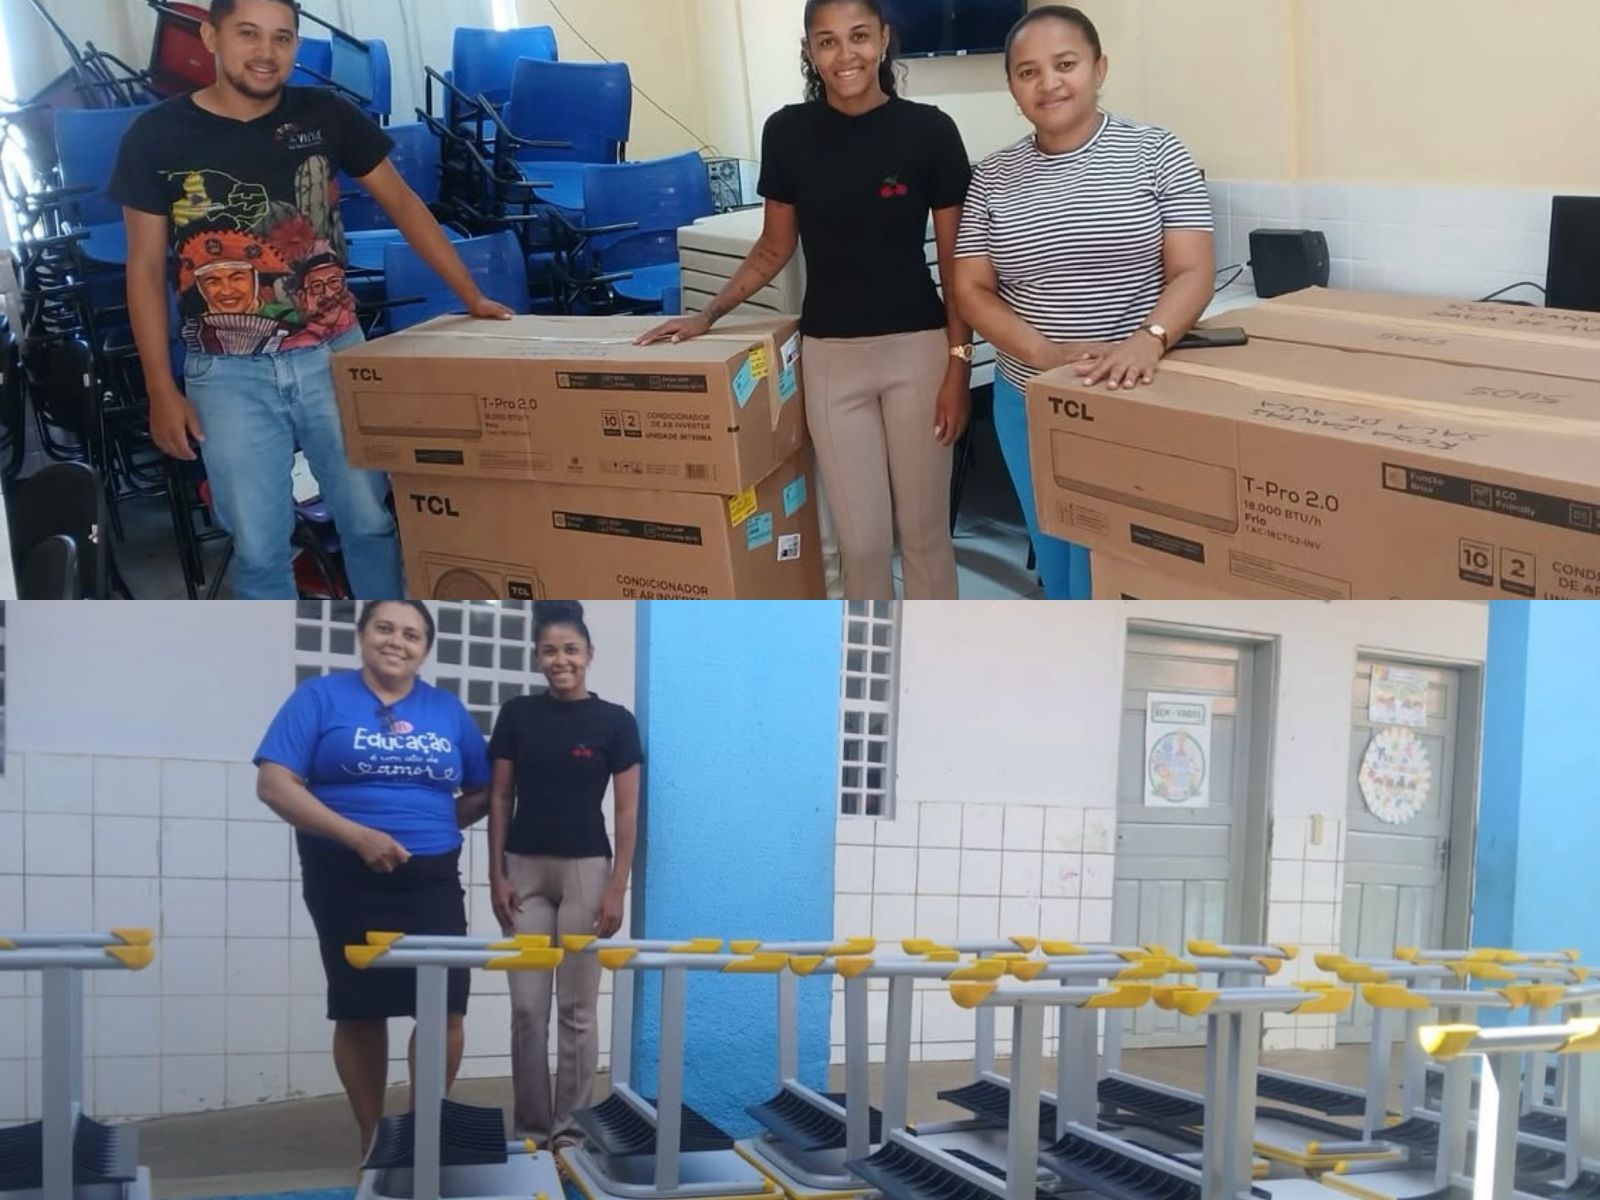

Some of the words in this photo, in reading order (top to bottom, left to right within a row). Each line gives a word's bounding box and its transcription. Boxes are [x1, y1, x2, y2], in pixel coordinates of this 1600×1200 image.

[348, 368, 383, 381] TCL
[481, 397, 516, 410] T-Pro
[1047, 396, 1094, 421] TCL
[604, 415, 617, 427] 10
[627, 415, 636, 427] 2
[646, 412, 710, 421] CONDICIONADOR
[1243, 476, 1300, 503] T-Pro
[1306, 490, 1339, 513] 2.0
[410, 493, 459, 517] TCL
[1244, 500, 1282, 517] 18.000
[1285, 509, 1322, 527] BTU/h
[1245, 513, 1266, 526] Frio
[1463, 549, 1489, 569] 10
[1511, 558, 1525, 578] 2
[511, 585, 530, 597] TCL
[616, 574, 709, 596] CONDICIONADOR
[1559, 577, 1579, 592] DE
[623, 587, 638, 599] DE
[353, 727, 452, 754] Educação
[377, 764, 436, 779] amor
